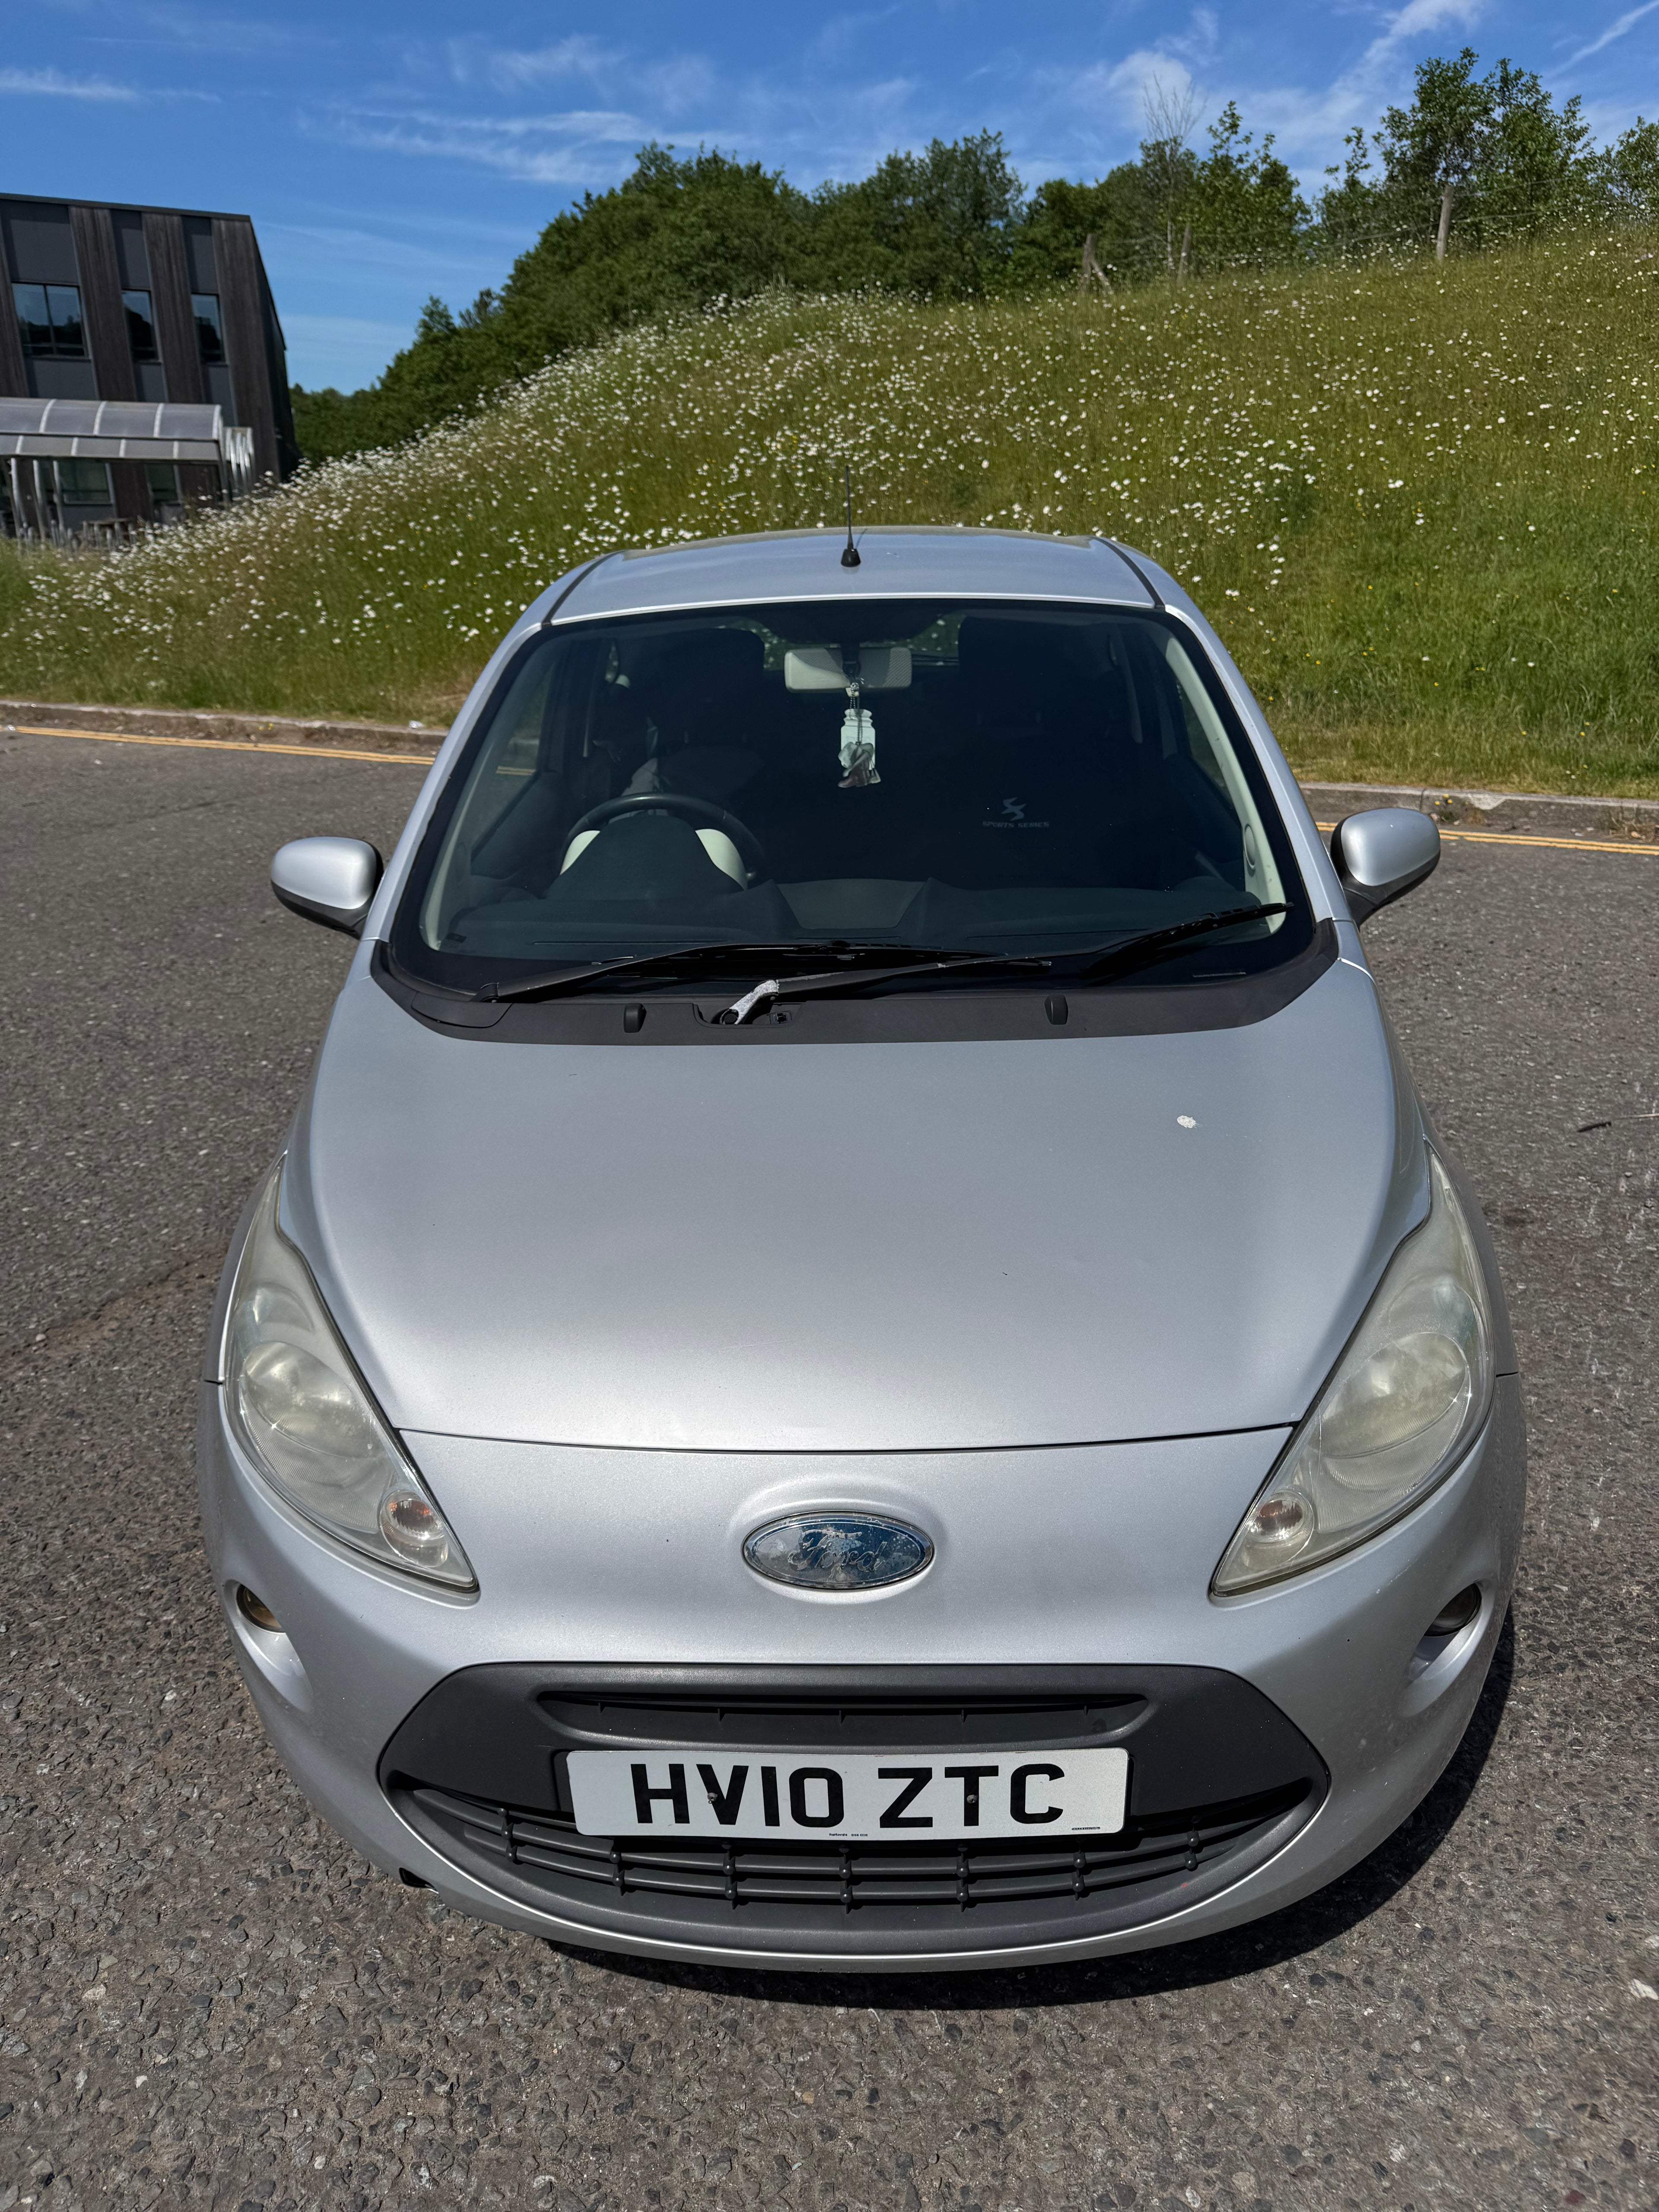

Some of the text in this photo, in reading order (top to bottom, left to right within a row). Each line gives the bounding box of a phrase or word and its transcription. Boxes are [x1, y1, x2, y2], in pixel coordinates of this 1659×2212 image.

[787, 1529, 887, 1572] Ford
[630, 1763, 1065, 1828] HV10 ZTC
